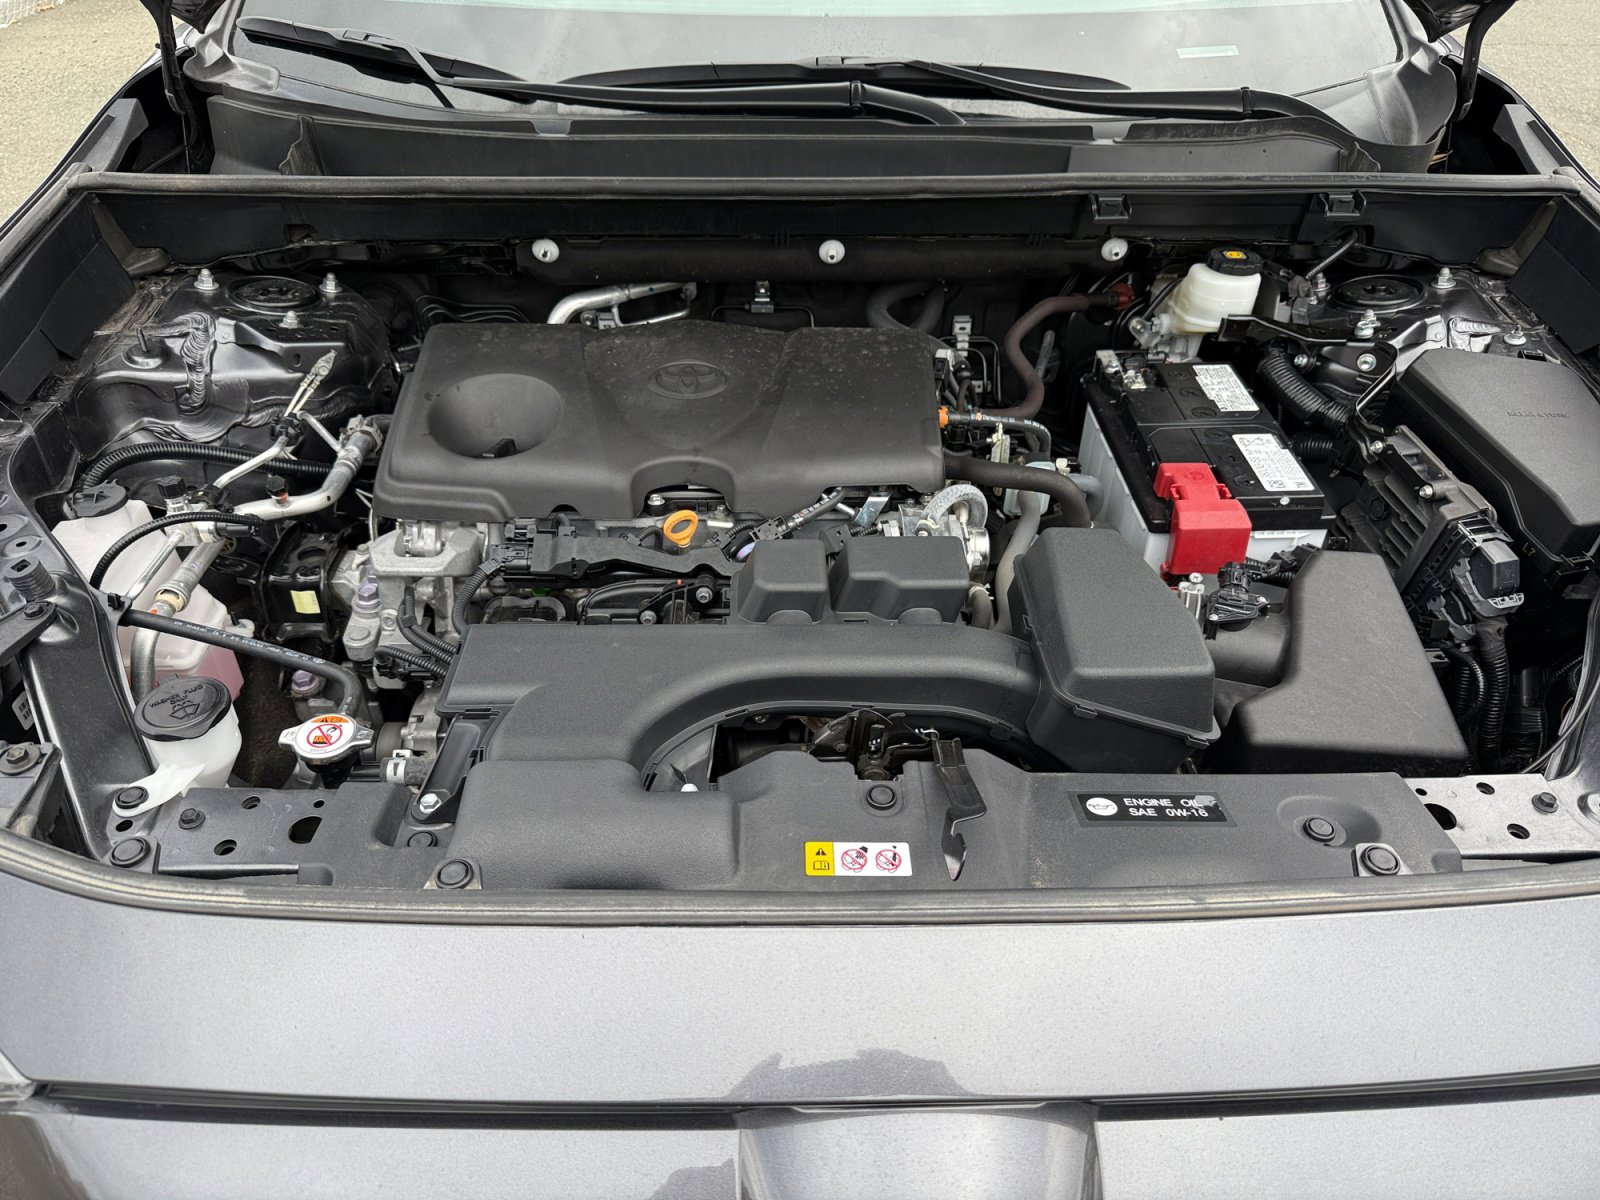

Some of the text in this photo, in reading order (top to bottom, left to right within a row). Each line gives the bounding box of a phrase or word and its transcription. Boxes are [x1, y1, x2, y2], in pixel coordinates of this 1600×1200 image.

[1123, 798, 1203, 807] ENGINE OIL
[1129, 808, 1209, 817] SAE 0W-16
